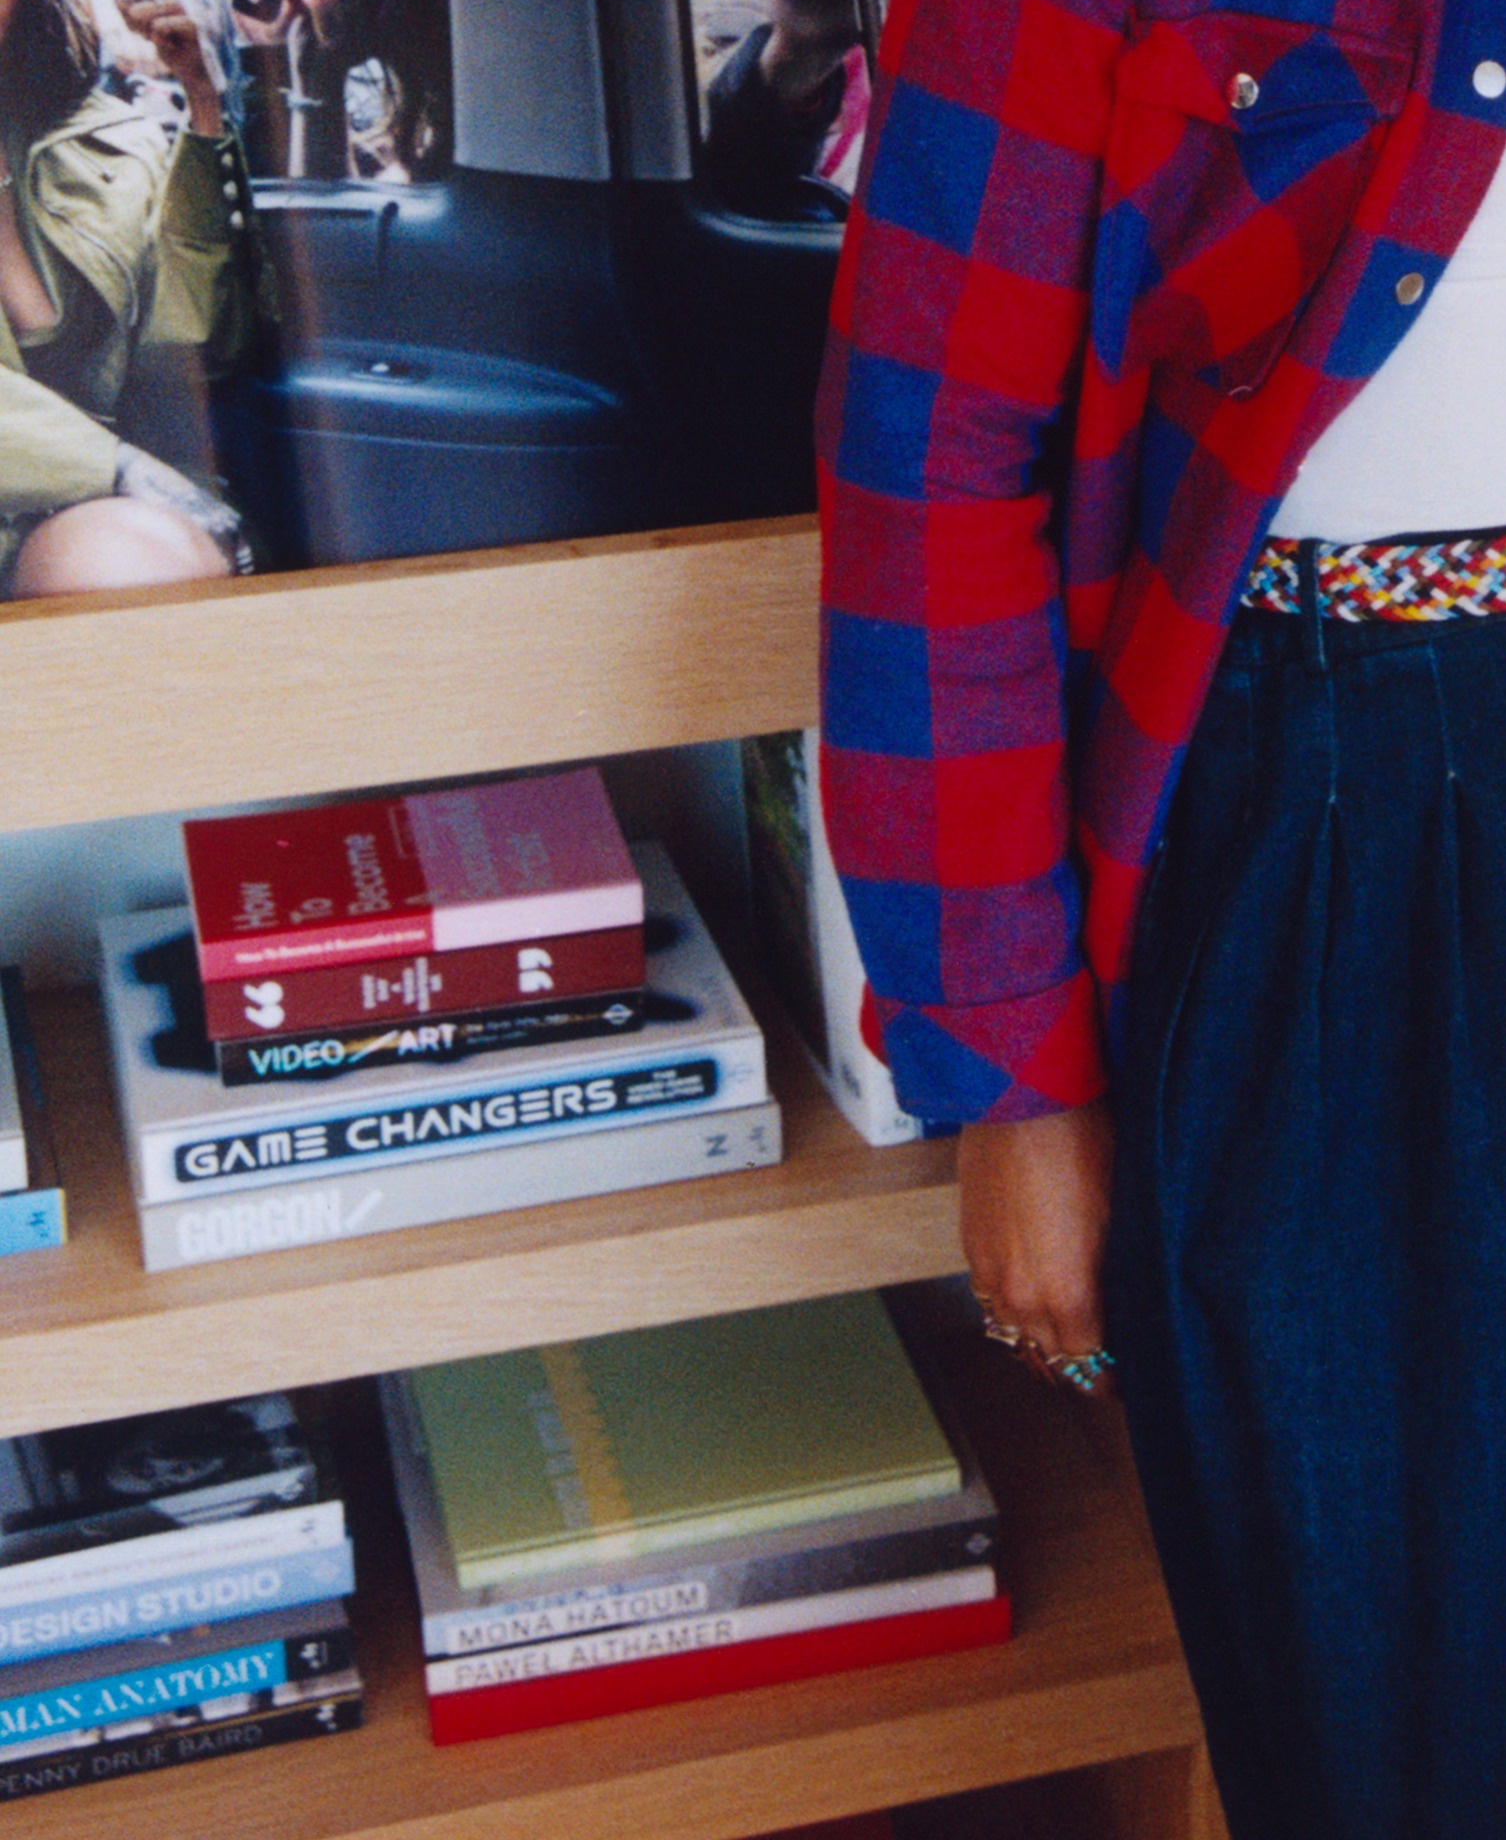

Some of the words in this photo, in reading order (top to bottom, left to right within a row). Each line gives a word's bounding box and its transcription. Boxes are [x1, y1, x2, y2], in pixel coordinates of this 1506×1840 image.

[247, 1039, 346, 1077] VIDEO
[398, 1022, 457, 1055] ART
[183, 1125, 328, 1177] GAME
[345, 1078, 617, 1153] CHANGERS
[137, 1566, 282, 1622] STUDIO
[457, 1613, 555, 1649] MONA
[566, 1586, 702, 1636] HATOUM
[569, 1619, 734, 1670] ALTHAMER
[93, 1650, 278, 1720] ANATOMY
